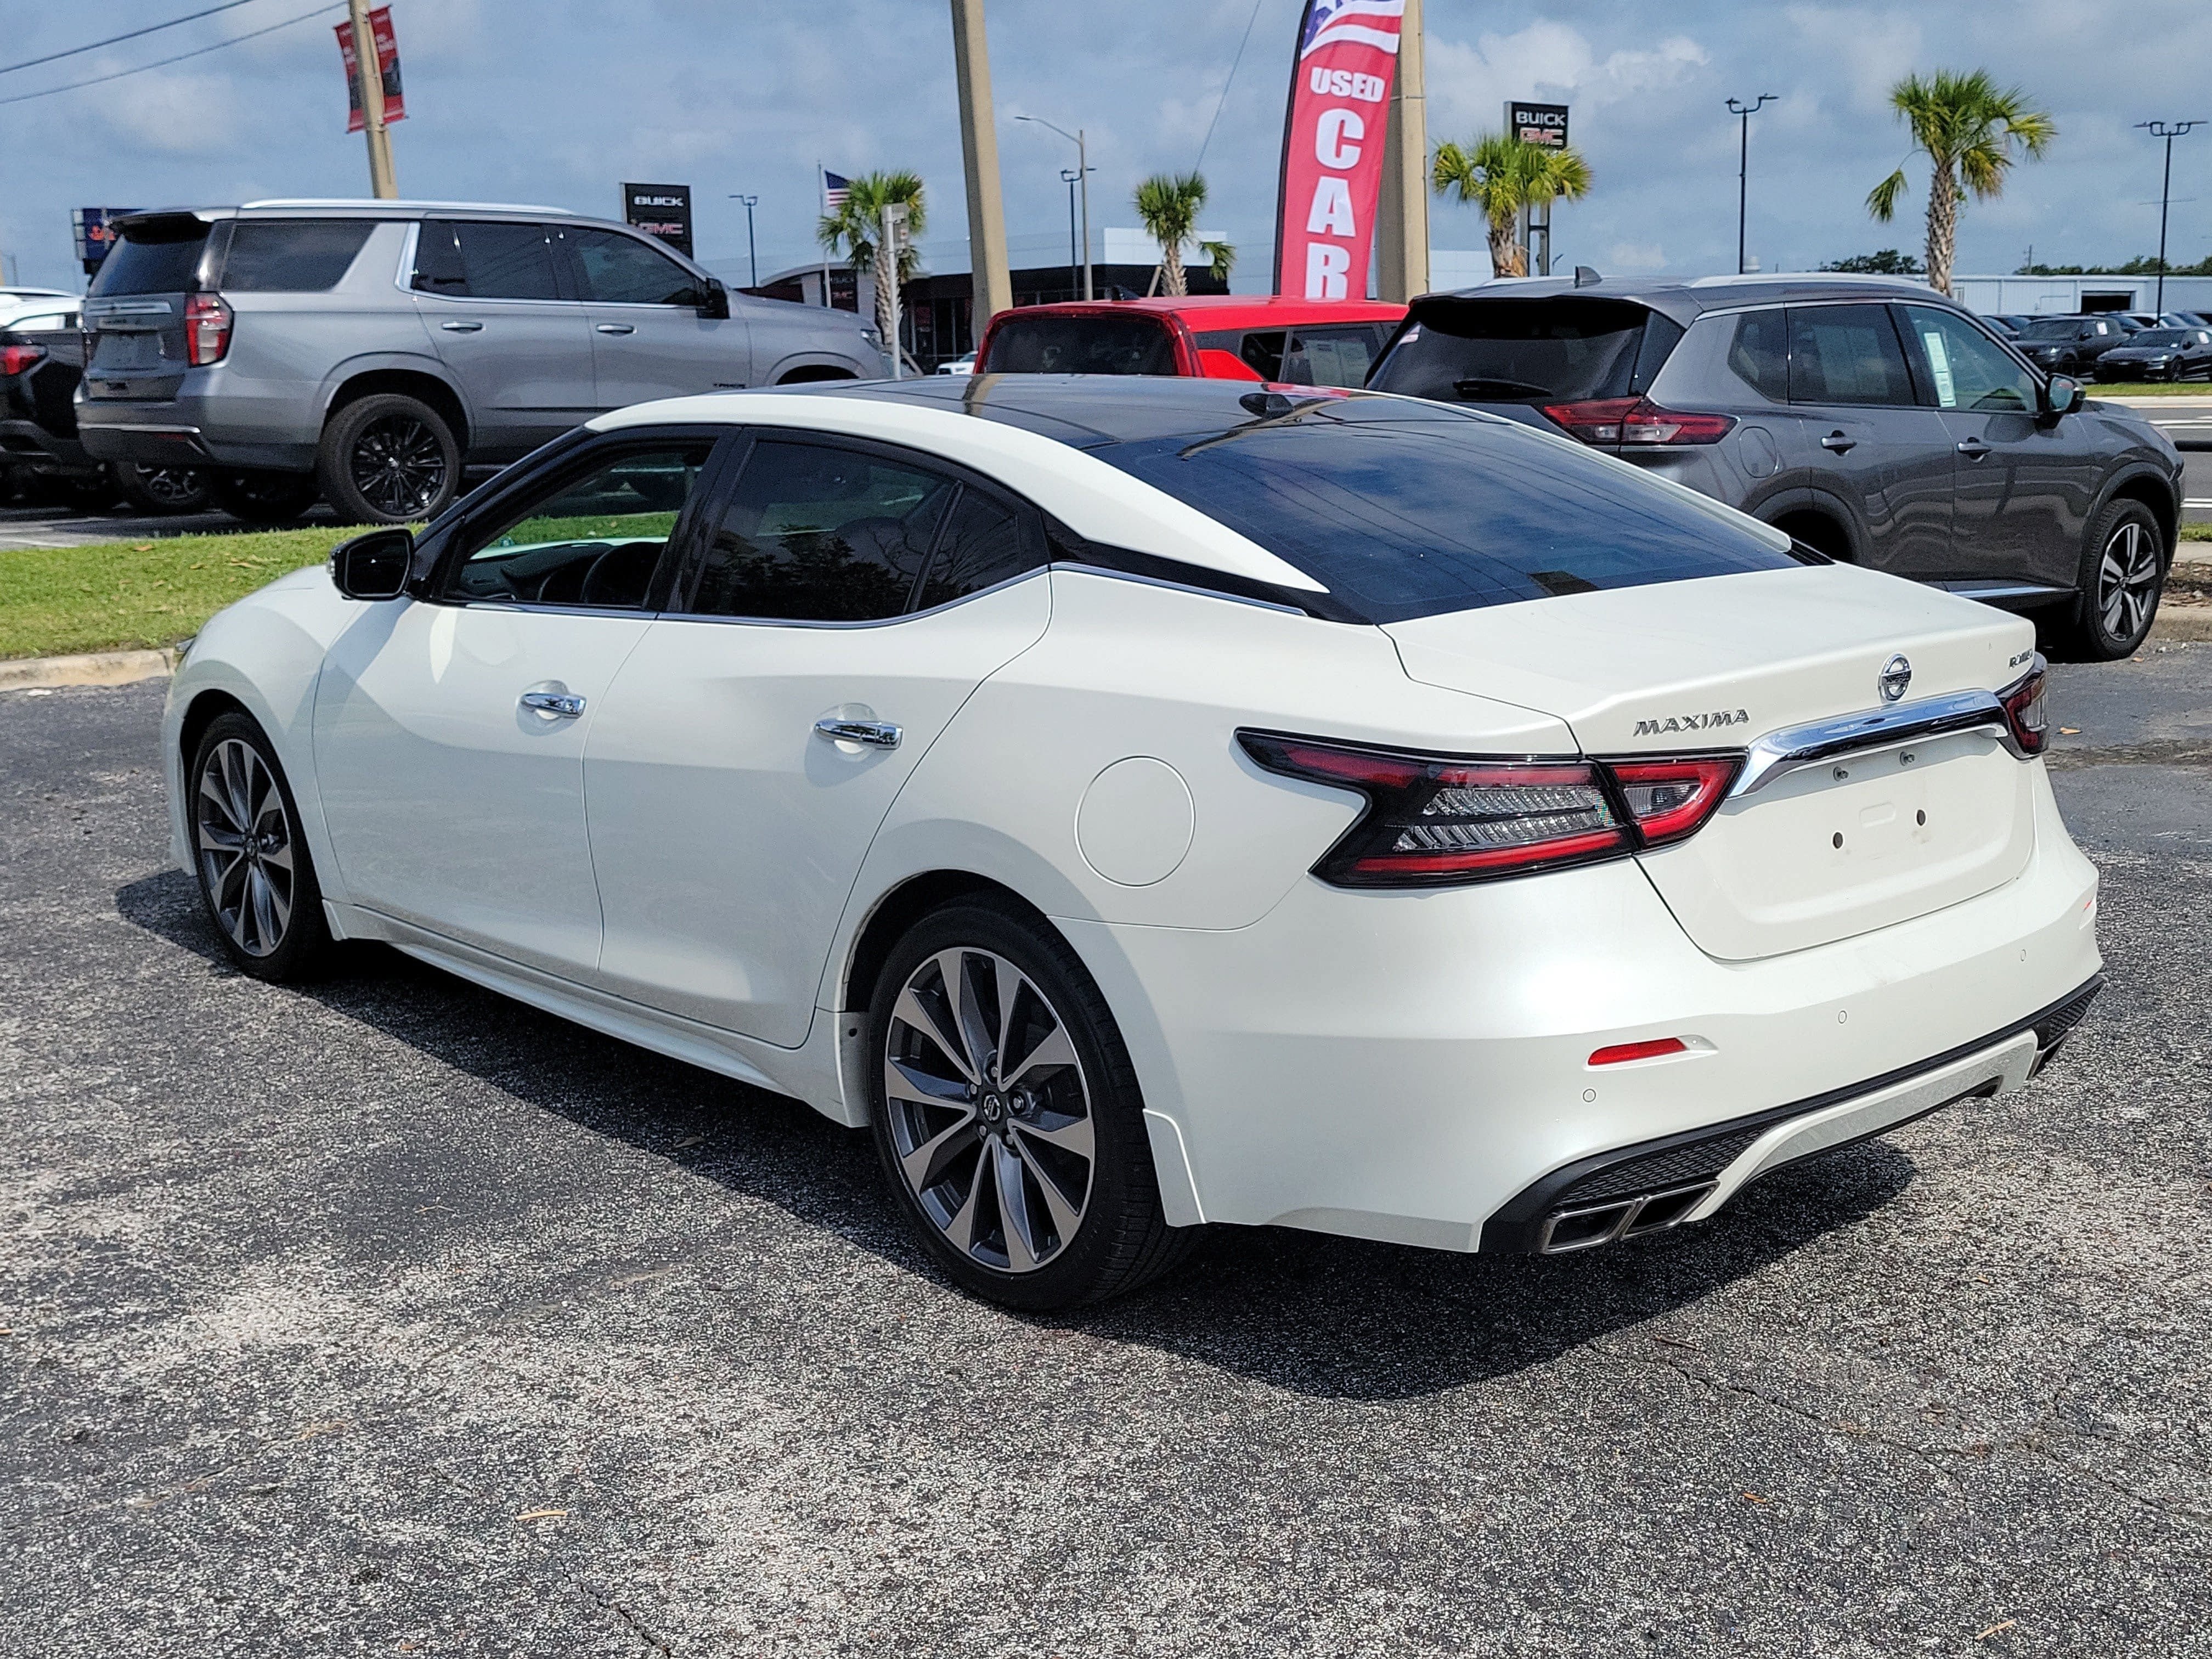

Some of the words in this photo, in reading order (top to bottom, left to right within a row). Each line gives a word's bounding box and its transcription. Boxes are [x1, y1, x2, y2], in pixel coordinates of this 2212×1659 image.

[1310, 67, 1385, 103] USED
[1515, 111, 1566, 126] BUICK
[1520, 127, 1564, 145] GMC
[634, 196, 684, 206] BUICK
[1305, 108, 1365, 300] CAR
[639, 222, 683, 234] GMC
[1633, 709, 1750, 737] MAXIMA
